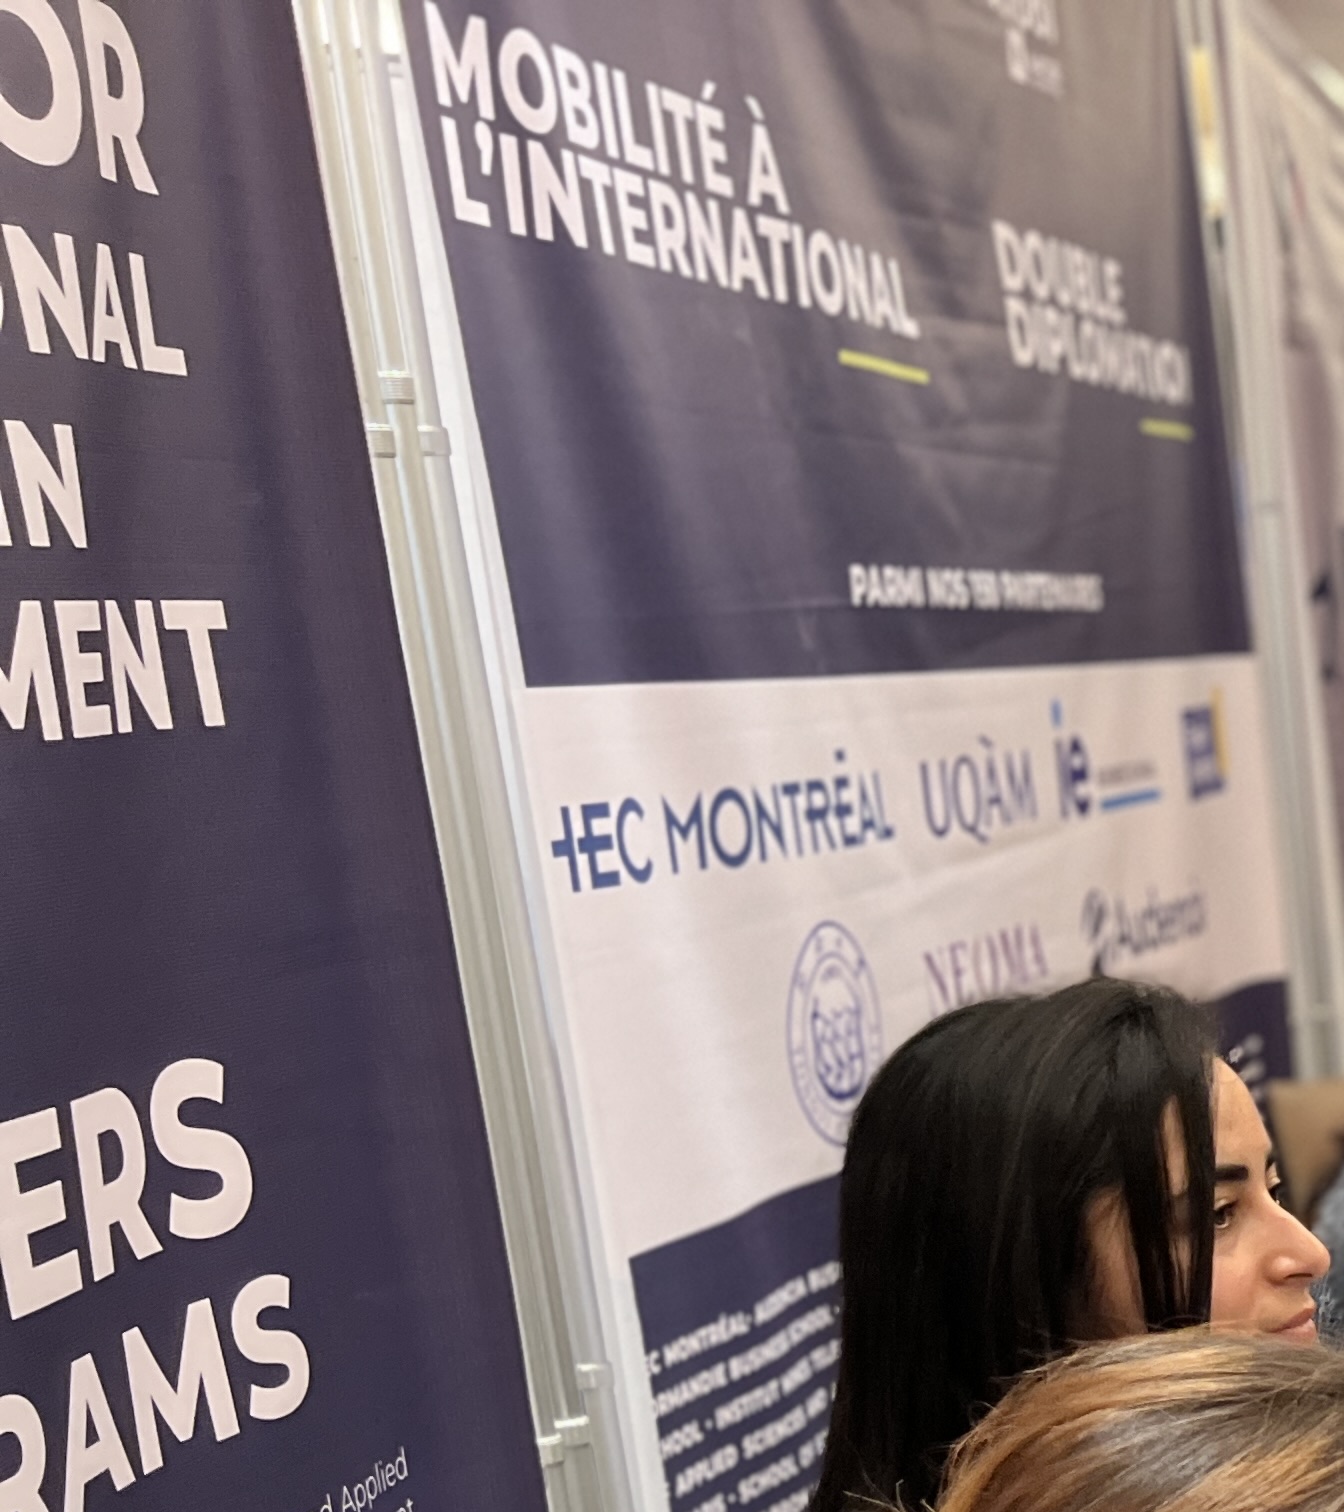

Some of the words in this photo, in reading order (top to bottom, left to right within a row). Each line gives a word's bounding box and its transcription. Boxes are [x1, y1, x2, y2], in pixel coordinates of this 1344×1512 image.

[425, 2, 733, 197] MOBILITÉ
[744, 96, 792, 213] À
[440, 117, 922, 338] L'INTERNATIONAL
[991, 217, 1127, 328] DOUBLE
[0, 224, 188, 377] NAL
[848, 562, 925, 608] PARMI
[661, 750, 895, 875] MONTRÉAL
[919, 734, 1039, 845] UQÀM
[662, 1310, 749, 1369] MONTRÉAL
